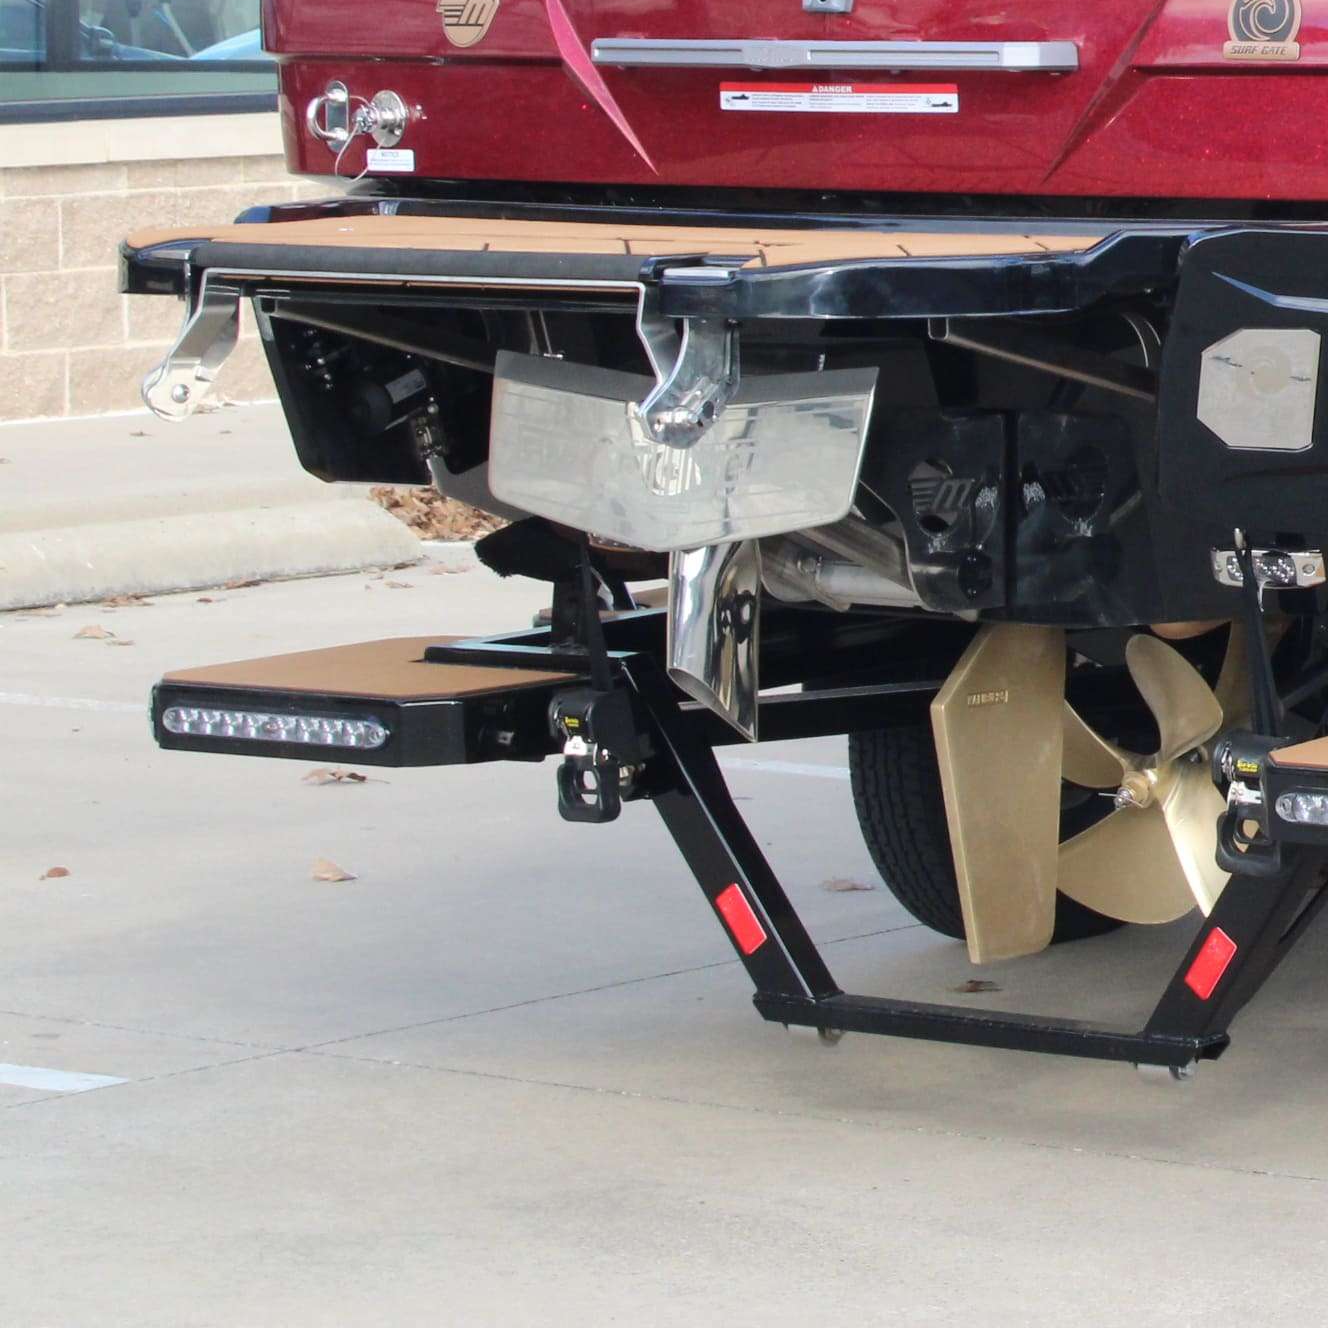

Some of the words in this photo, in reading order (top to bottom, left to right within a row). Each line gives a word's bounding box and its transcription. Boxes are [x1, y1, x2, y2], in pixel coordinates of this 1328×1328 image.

[1229, 44, 1258, 55] SURF
[1261, 46, 1288, 56] GATE
[817, 85, 853, 93] DANGER
